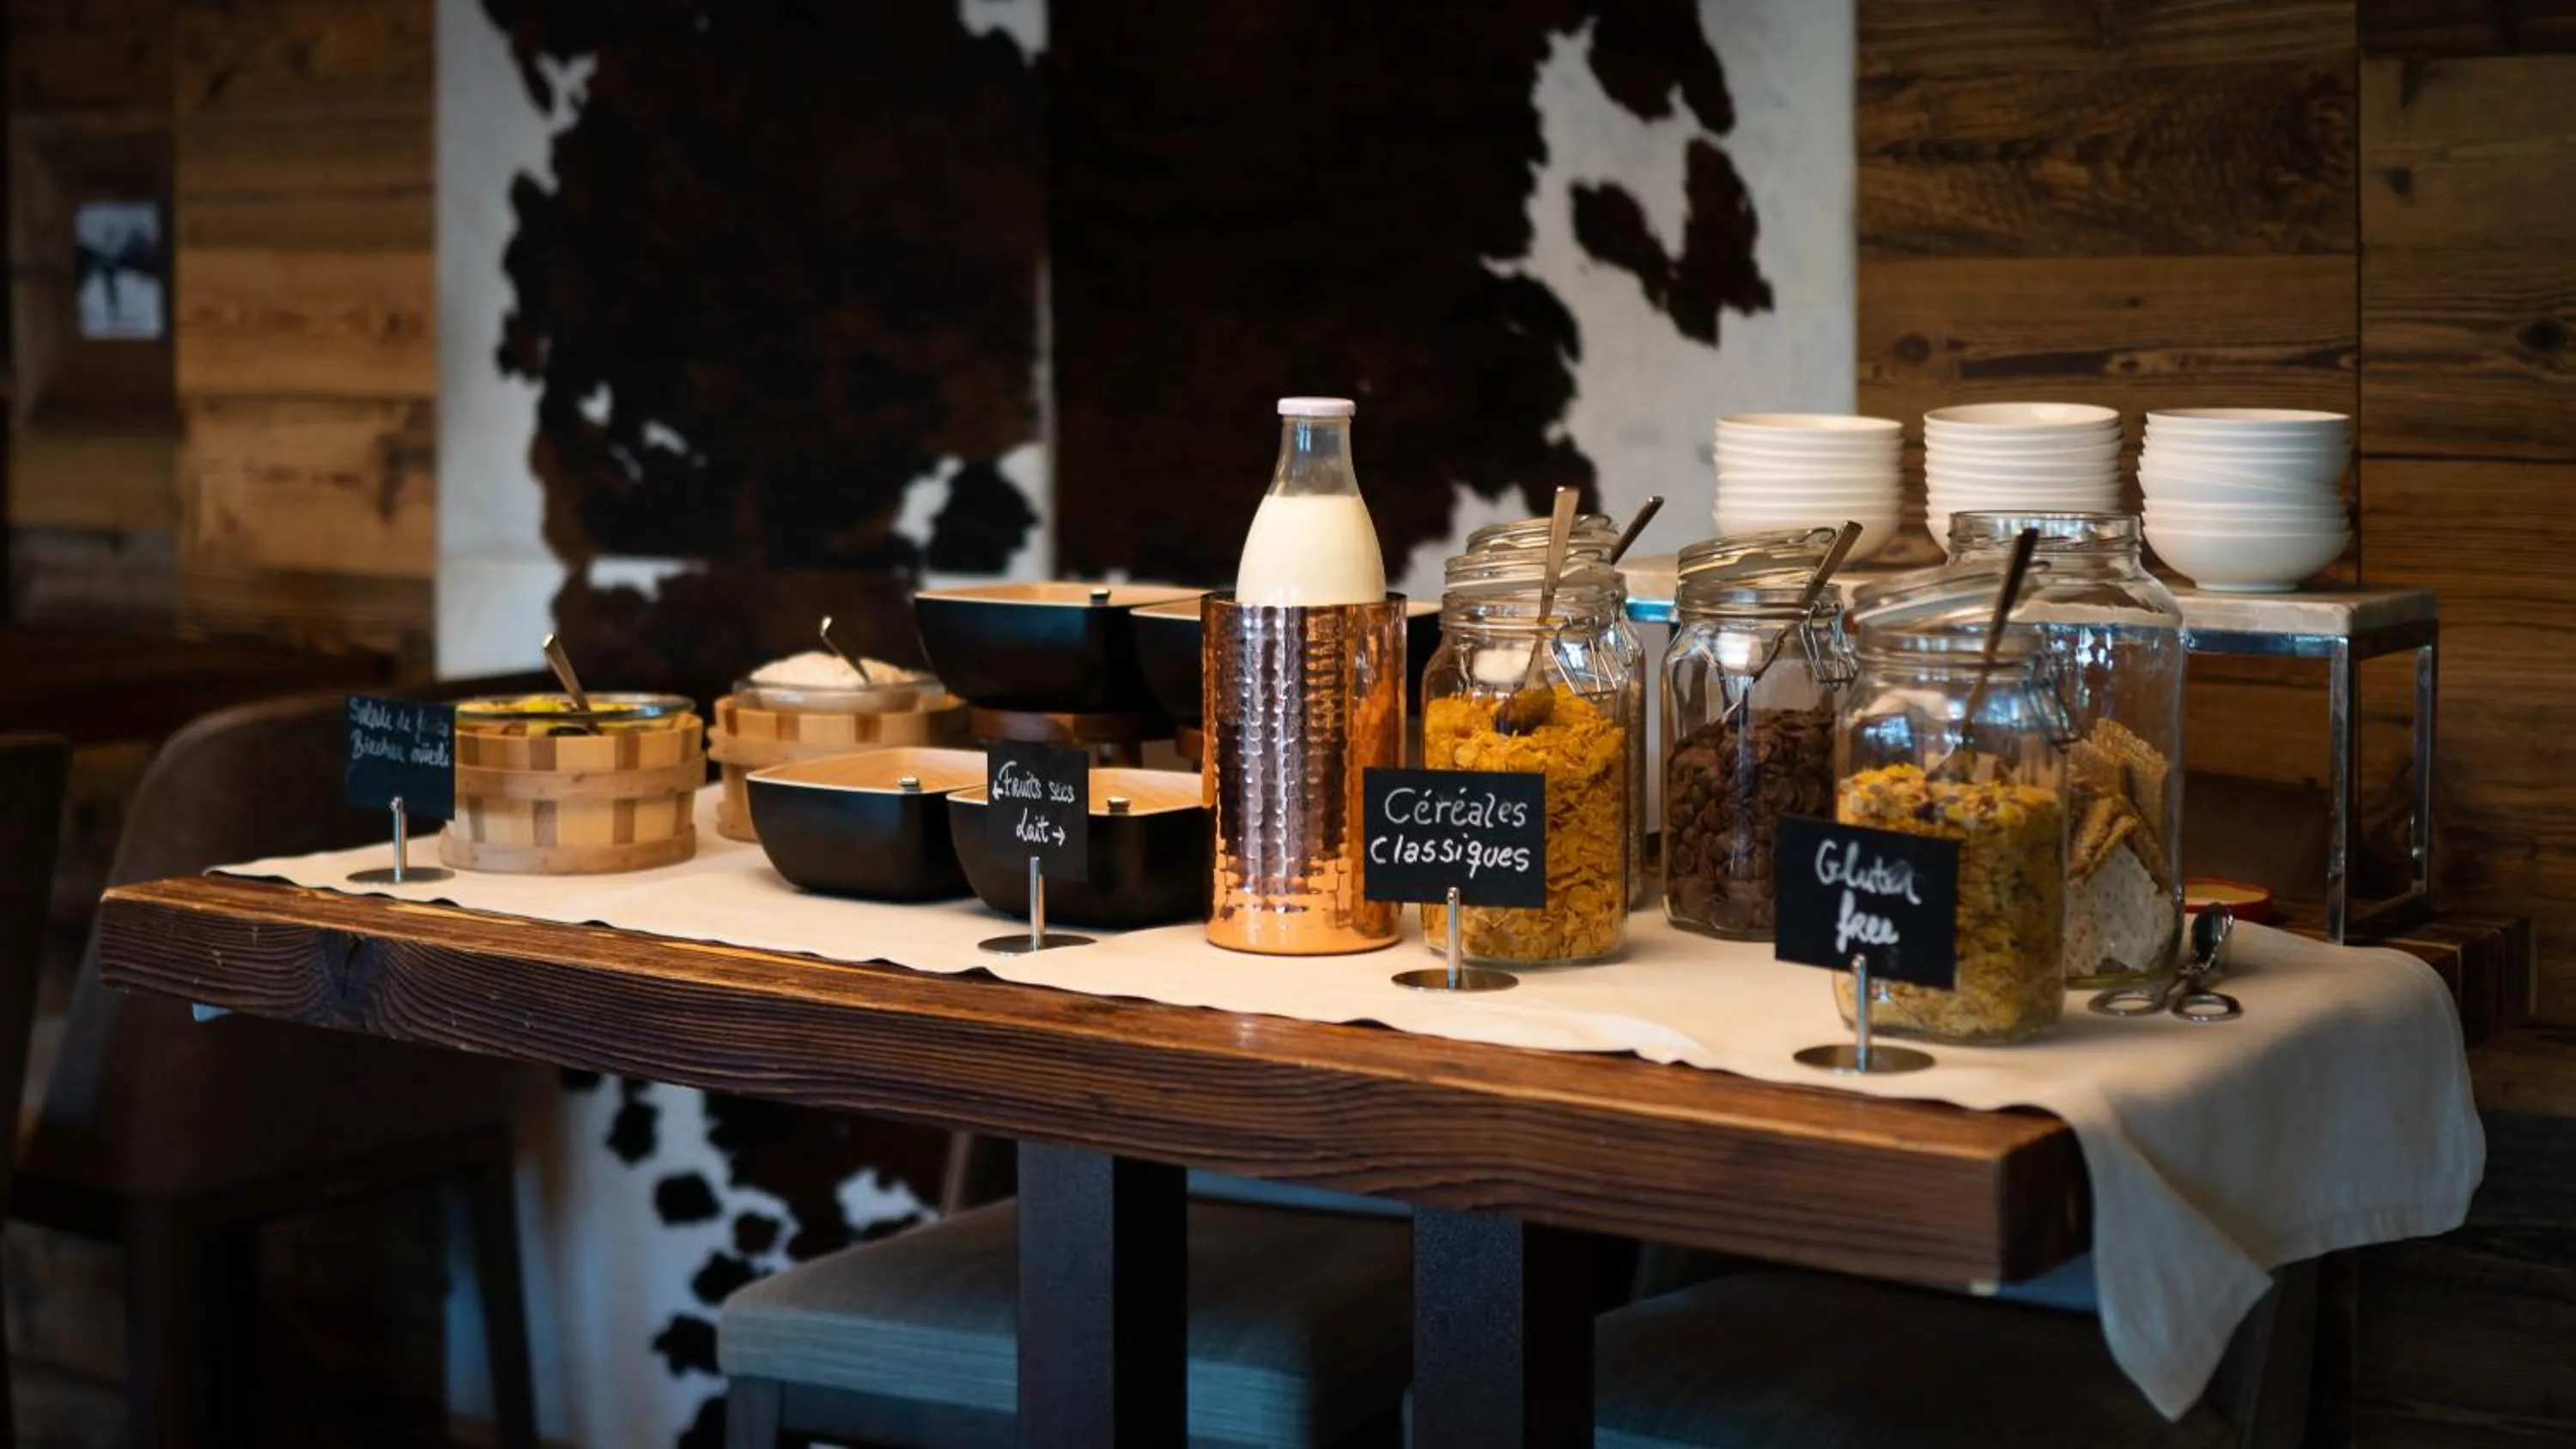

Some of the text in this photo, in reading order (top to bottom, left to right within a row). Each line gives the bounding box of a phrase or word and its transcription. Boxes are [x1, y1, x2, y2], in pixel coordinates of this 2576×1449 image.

[999, 760, 1075, 804] Fruits secs
[1384, 786, 1528, 828] Céréales
[1814, 839, 1923, 906] Gluten
[1835, 888, 1900, 954] free
